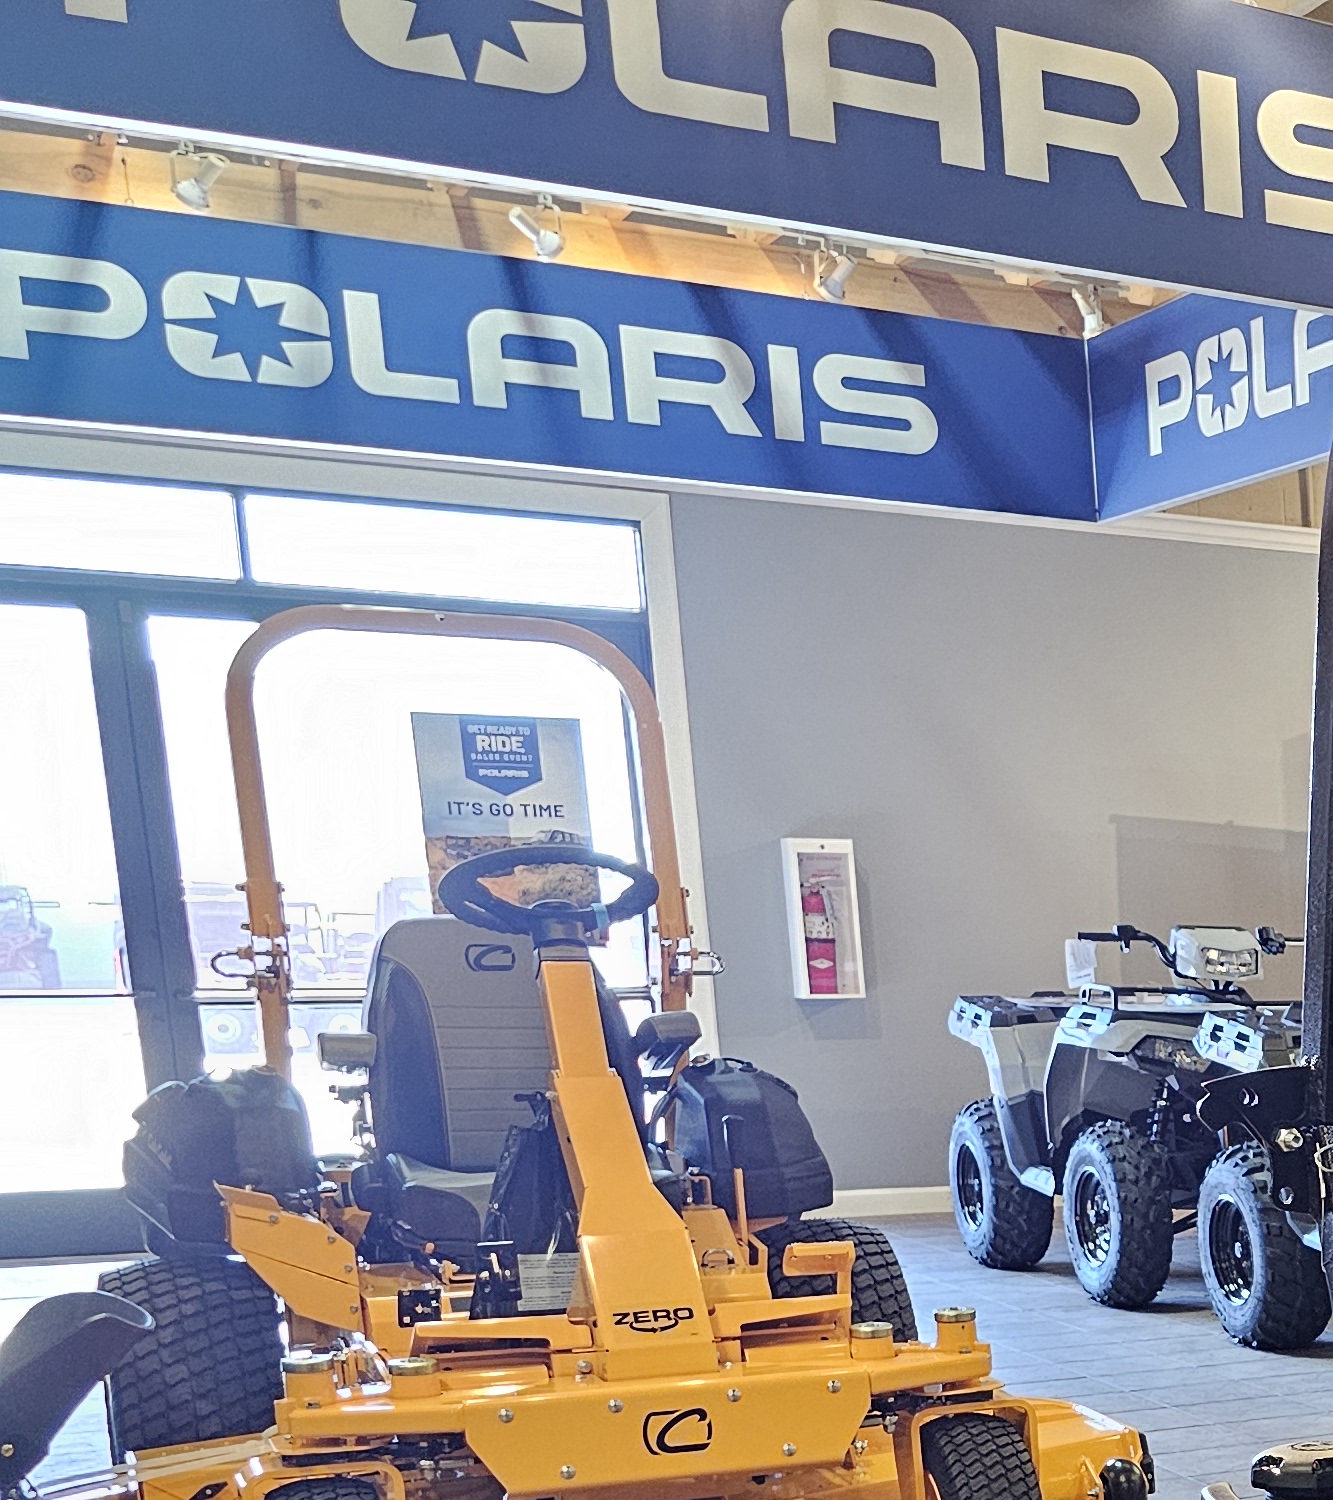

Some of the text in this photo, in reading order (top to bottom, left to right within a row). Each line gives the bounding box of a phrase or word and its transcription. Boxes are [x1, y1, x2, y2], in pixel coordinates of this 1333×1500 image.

[0, 250, 939, 455] POLARIS
[476, 735, 526, 753] RIDE
[447, 801, 565, 818] IT'S GO TIME
[612, 1307, 695, 1325] ZERO
